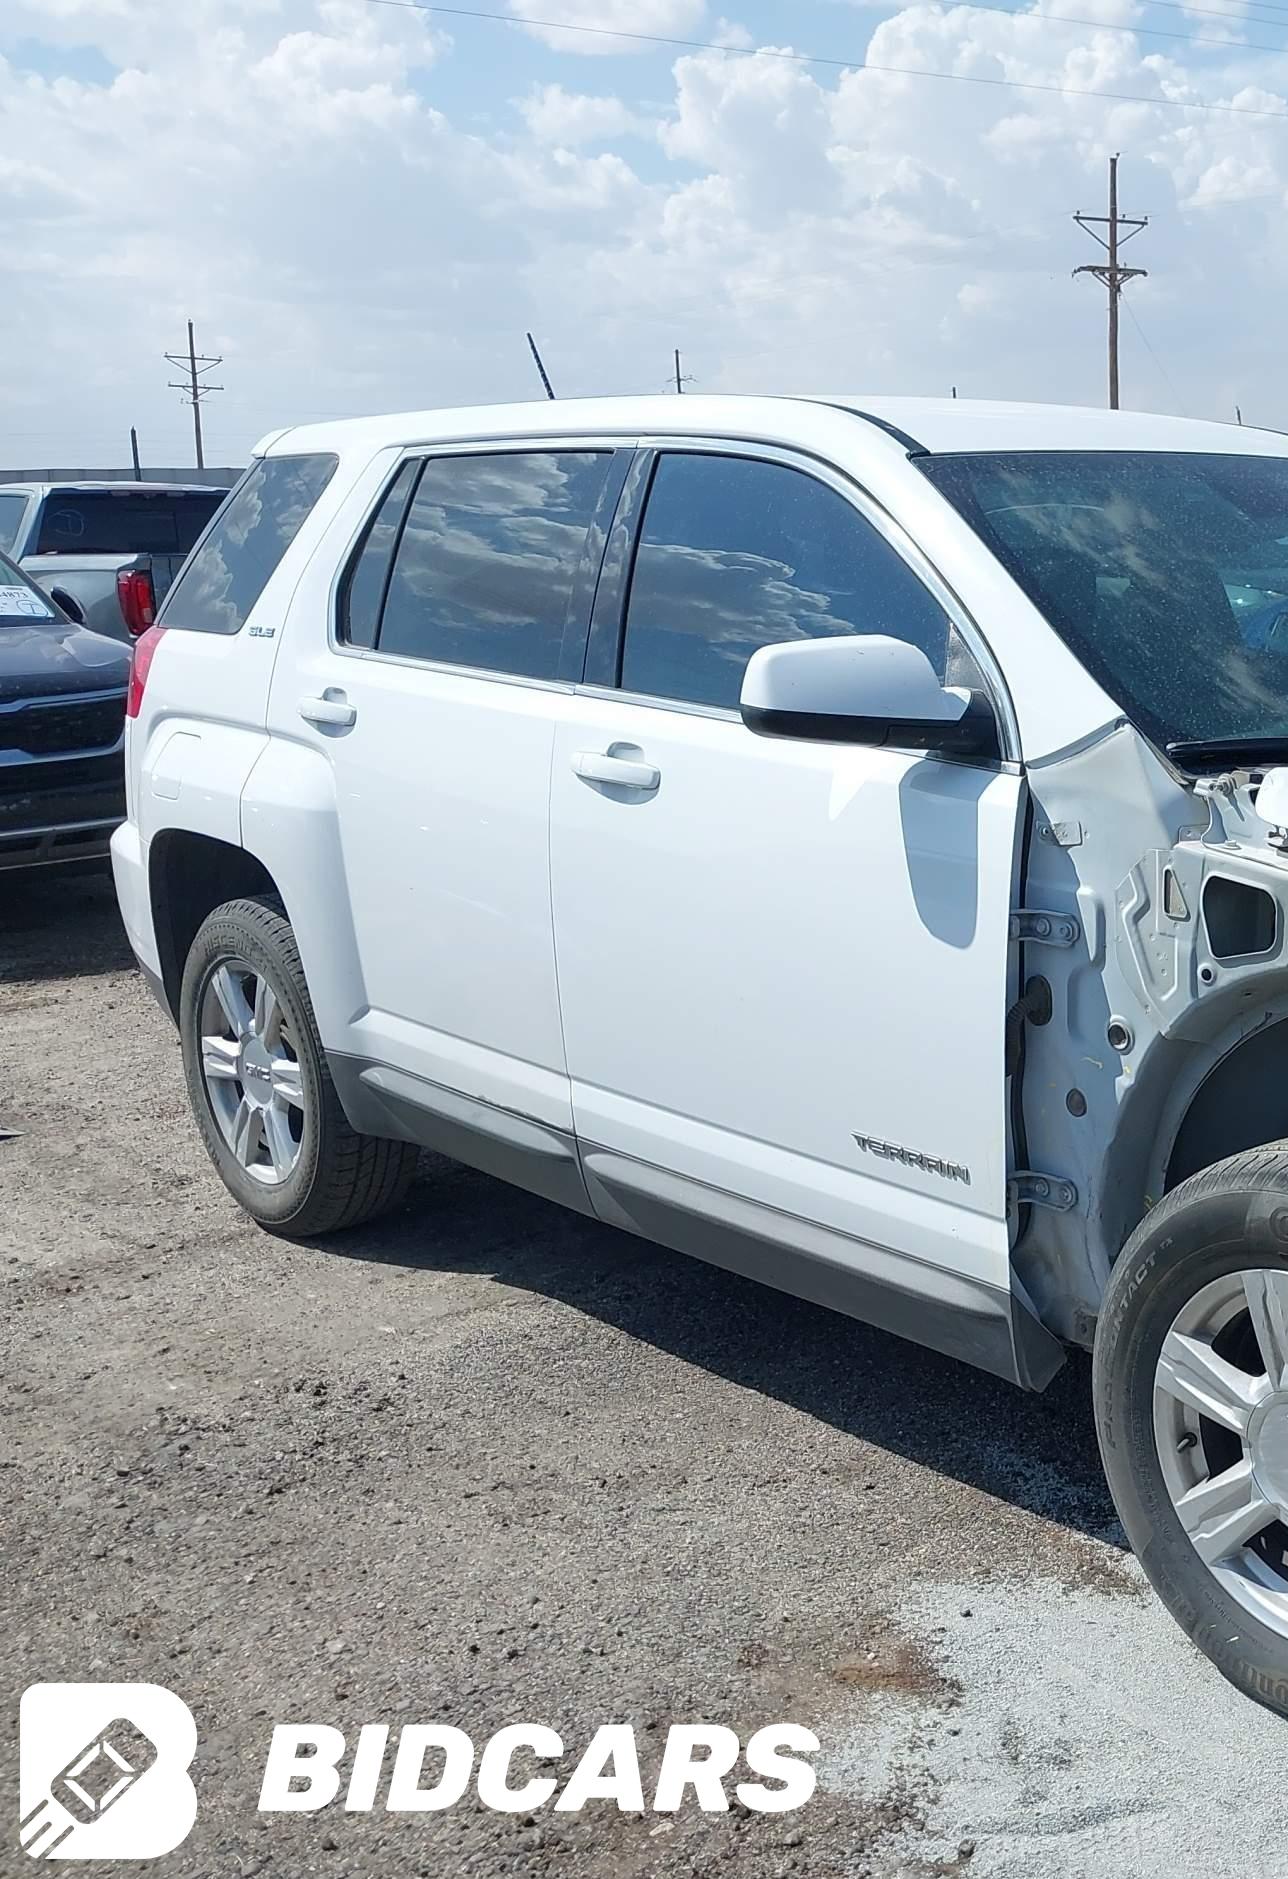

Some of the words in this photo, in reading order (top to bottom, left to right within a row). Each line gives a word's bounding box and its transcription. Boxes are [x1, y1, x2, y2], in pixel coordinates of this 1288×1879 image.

[0, 591, 29, 599] 4873
[248, 625, 276, 639] SLE
[850, 1130, 972, 1186] TERRAIN
